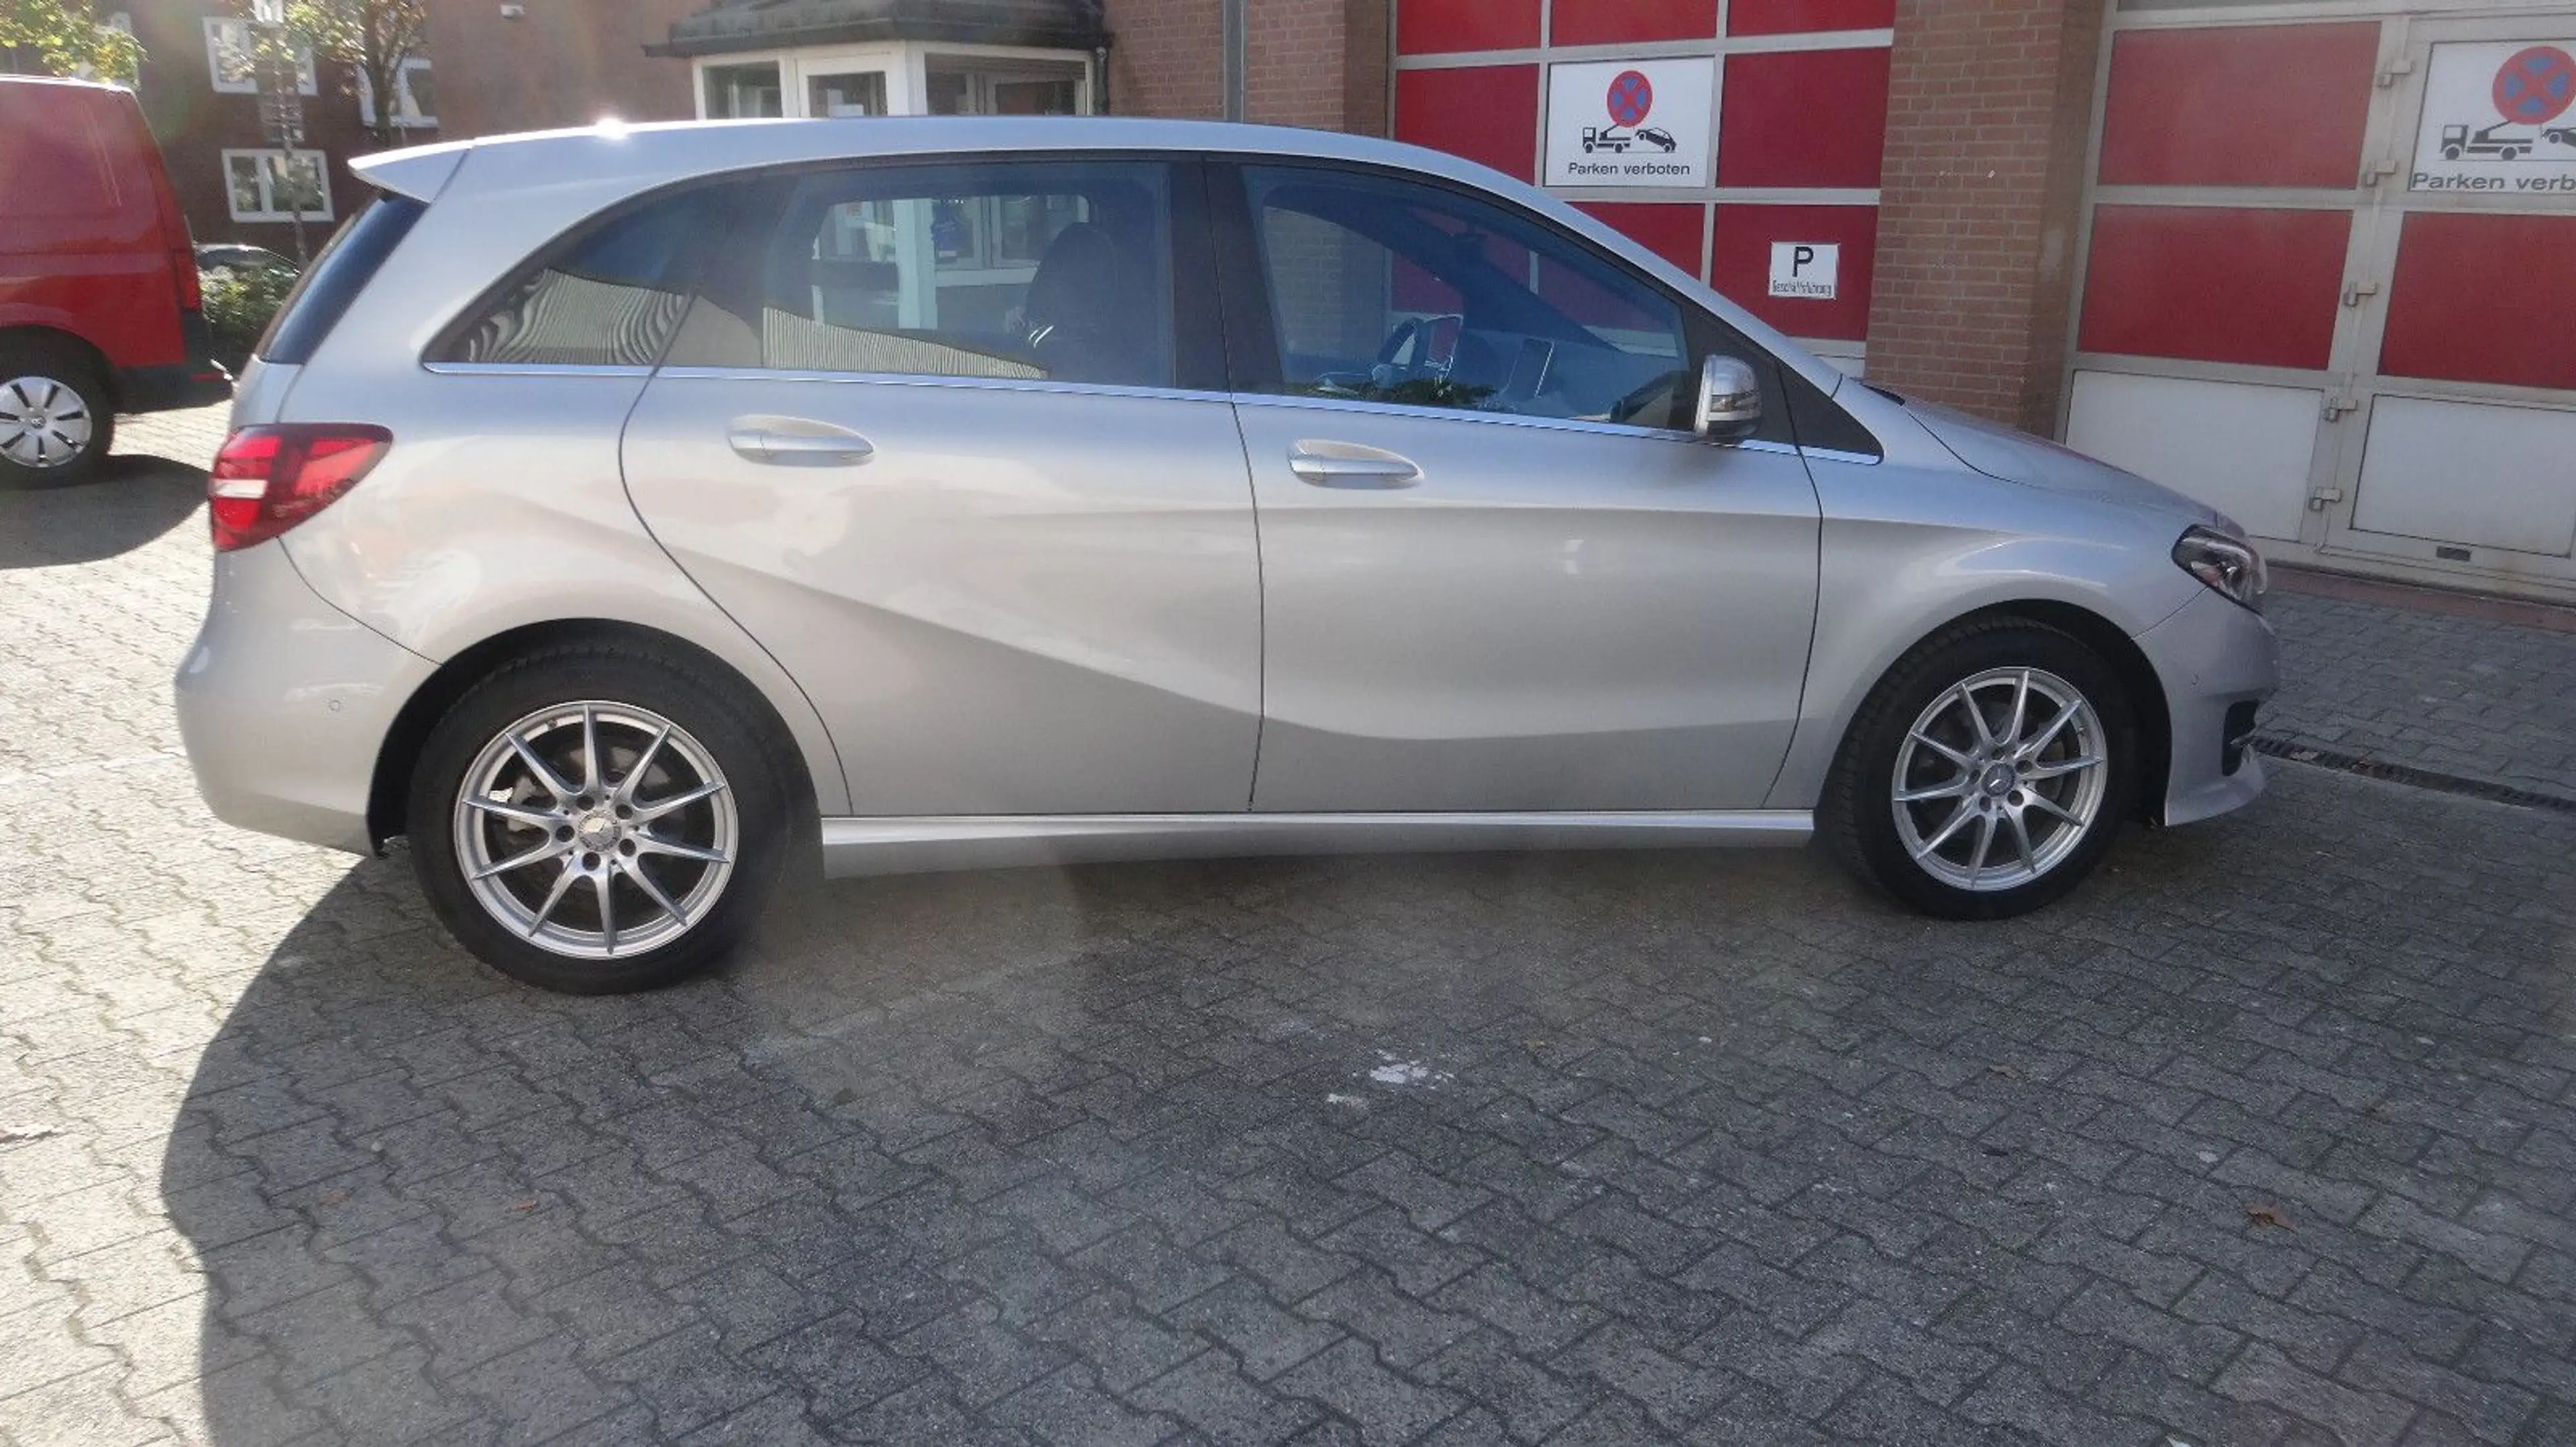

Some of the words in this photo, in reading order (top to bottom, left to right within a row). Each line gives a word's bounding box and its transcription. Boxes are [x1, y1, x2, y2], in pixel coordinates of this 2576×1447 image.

[1568, 162, 1619, 175] Parken
[1623, 162, 1690, 175] verboten
[2411, 172, 2505, 189] Parken
[1792, 246, 1814, 278] P
